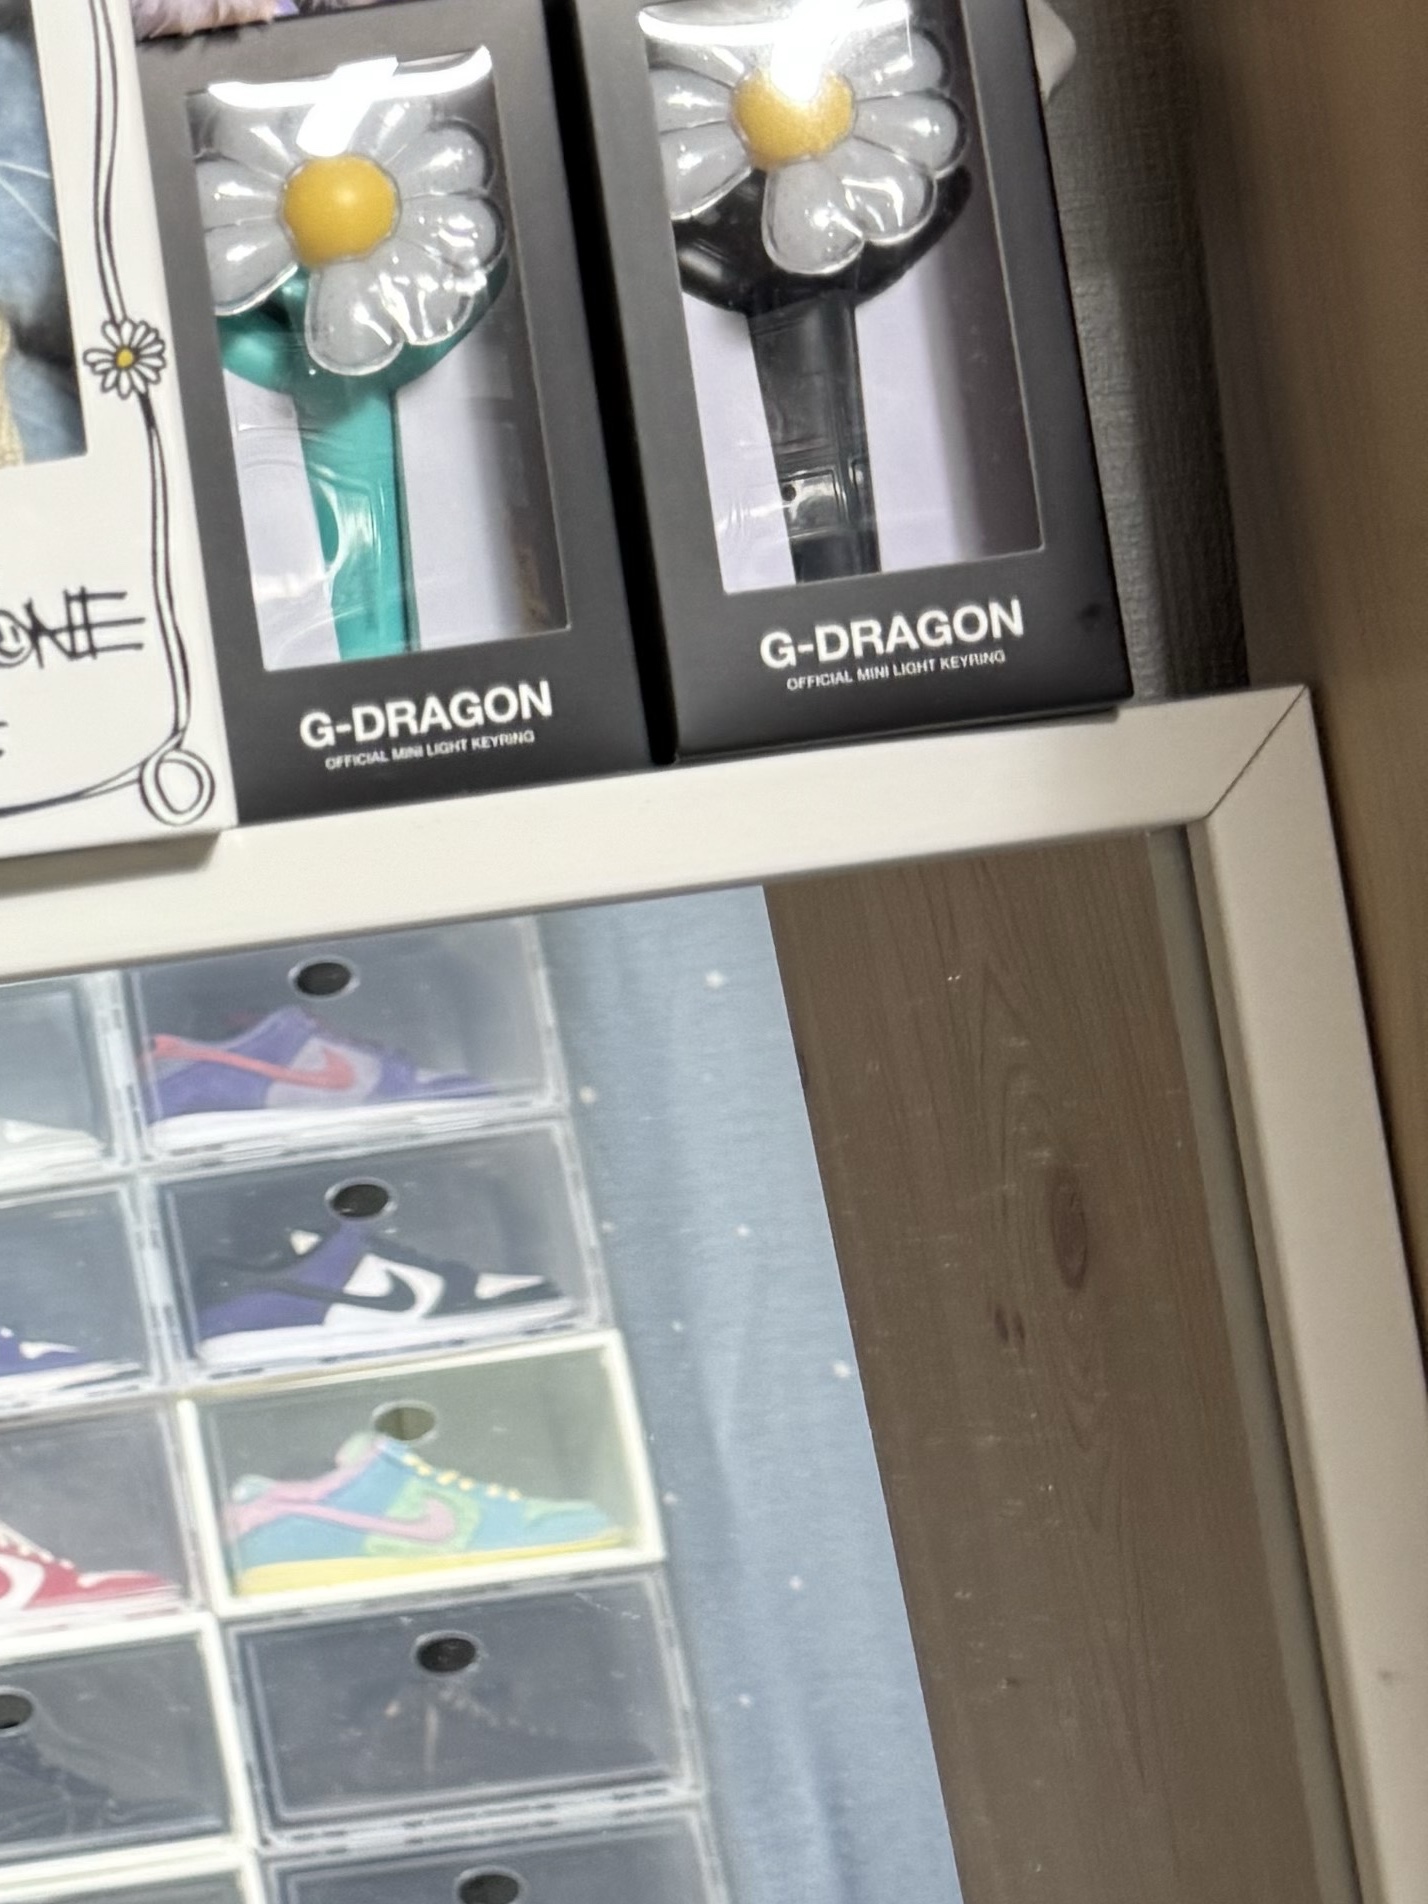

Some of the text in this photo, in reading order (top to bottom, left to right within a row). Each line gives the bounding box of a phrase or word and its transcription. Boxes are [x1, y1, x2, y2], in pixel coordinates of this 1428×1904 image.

[759, 597, 1025, 670] G-DRAGON
[786, 648, 1006, 691] OFFICIAL MINI LIGHT KEYRING
[299, 679, 553, 749] G-DRAGON
[324, 729, 536, 771] OFFICIAL MINI LIGHT KEYRING
